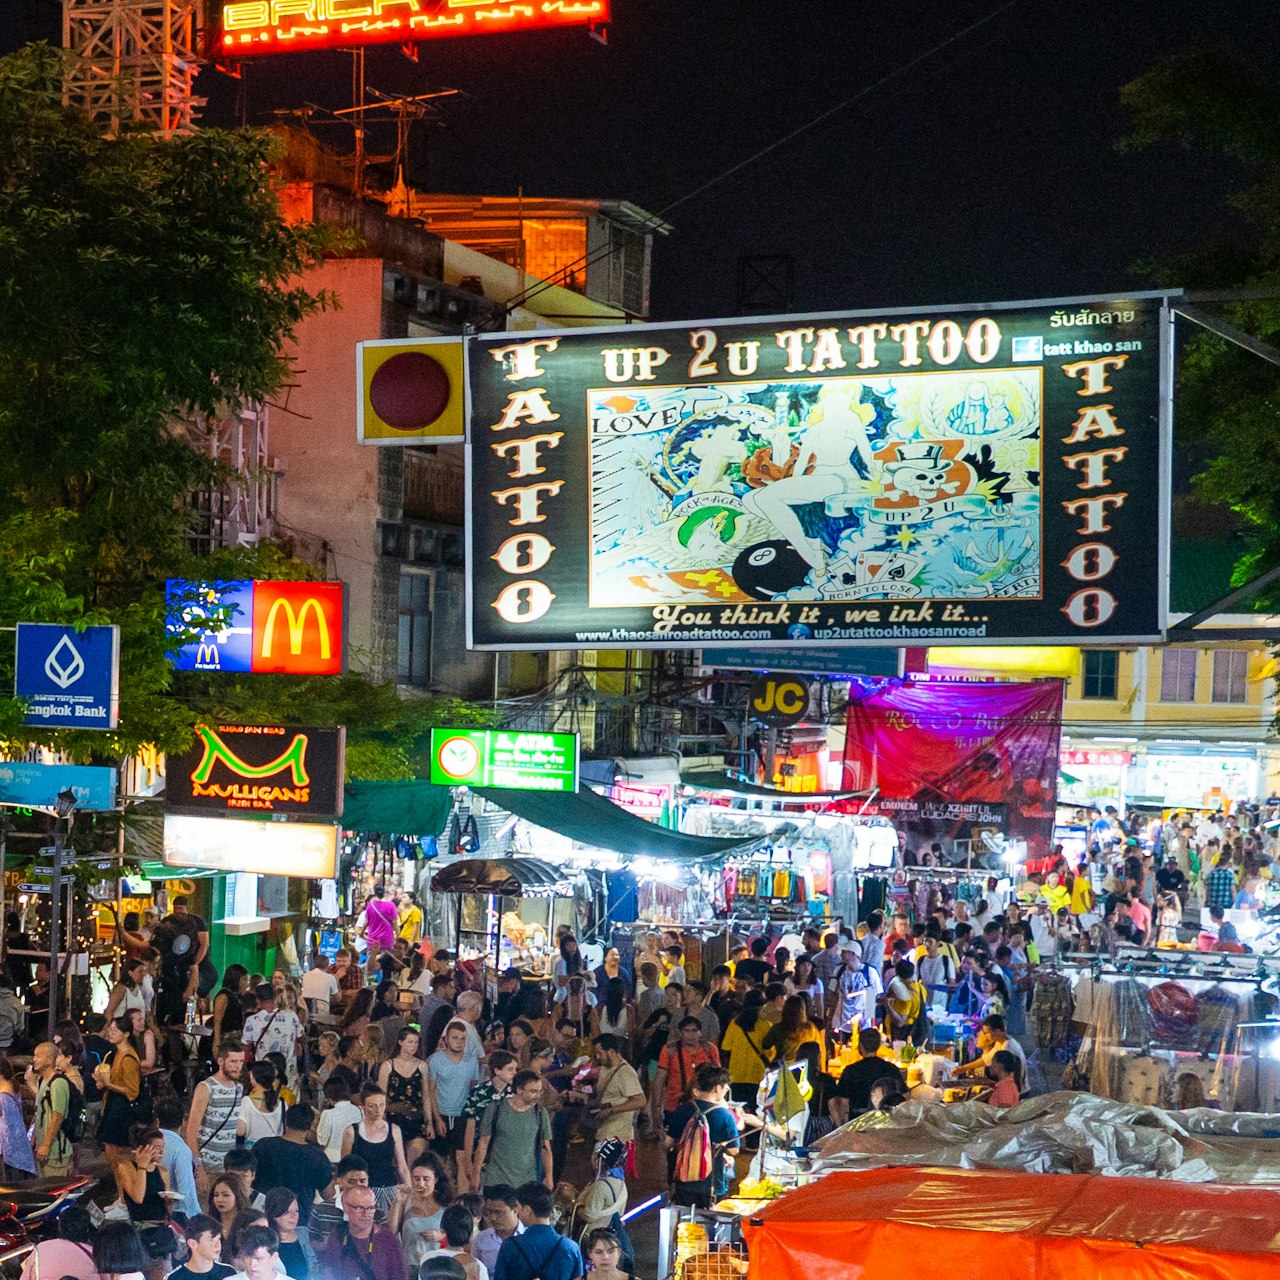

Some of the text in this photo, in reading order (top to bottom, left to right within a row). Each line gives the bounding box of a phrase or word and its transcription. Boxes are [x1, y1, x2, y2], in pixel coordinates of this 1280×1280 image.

[600, 317, 1002, 382] UP 2 U TATTOO
[1043, 340, 1142, 356] tatt khao san
[592, 406, 679, 434] LOVE
[488, 336, 565, 624] TATTOO
[1059, 354, 1129, 627] TATTOO
[885, 501, 956, 522] UP 2 U
[828, 588, 863, 600] BORN
[883, 583, 916, 595] LOSE
[652, 604, 713, 634] You
[720, 604, 791, 625] think
[798, 606, 821, 623] it
[844, 608, 881, 623] we
[888, 601, 934, 622] ink
[941, 604, 989, 622] it...
[575, 624, 987, 642] www.khaosanroadtattoo.com up2utattookhaosanroad
[753, 681, 804, 715] JC
[75, 705, 107, 718] Bank
[192, 782, 310, 803] MULLIGANS
